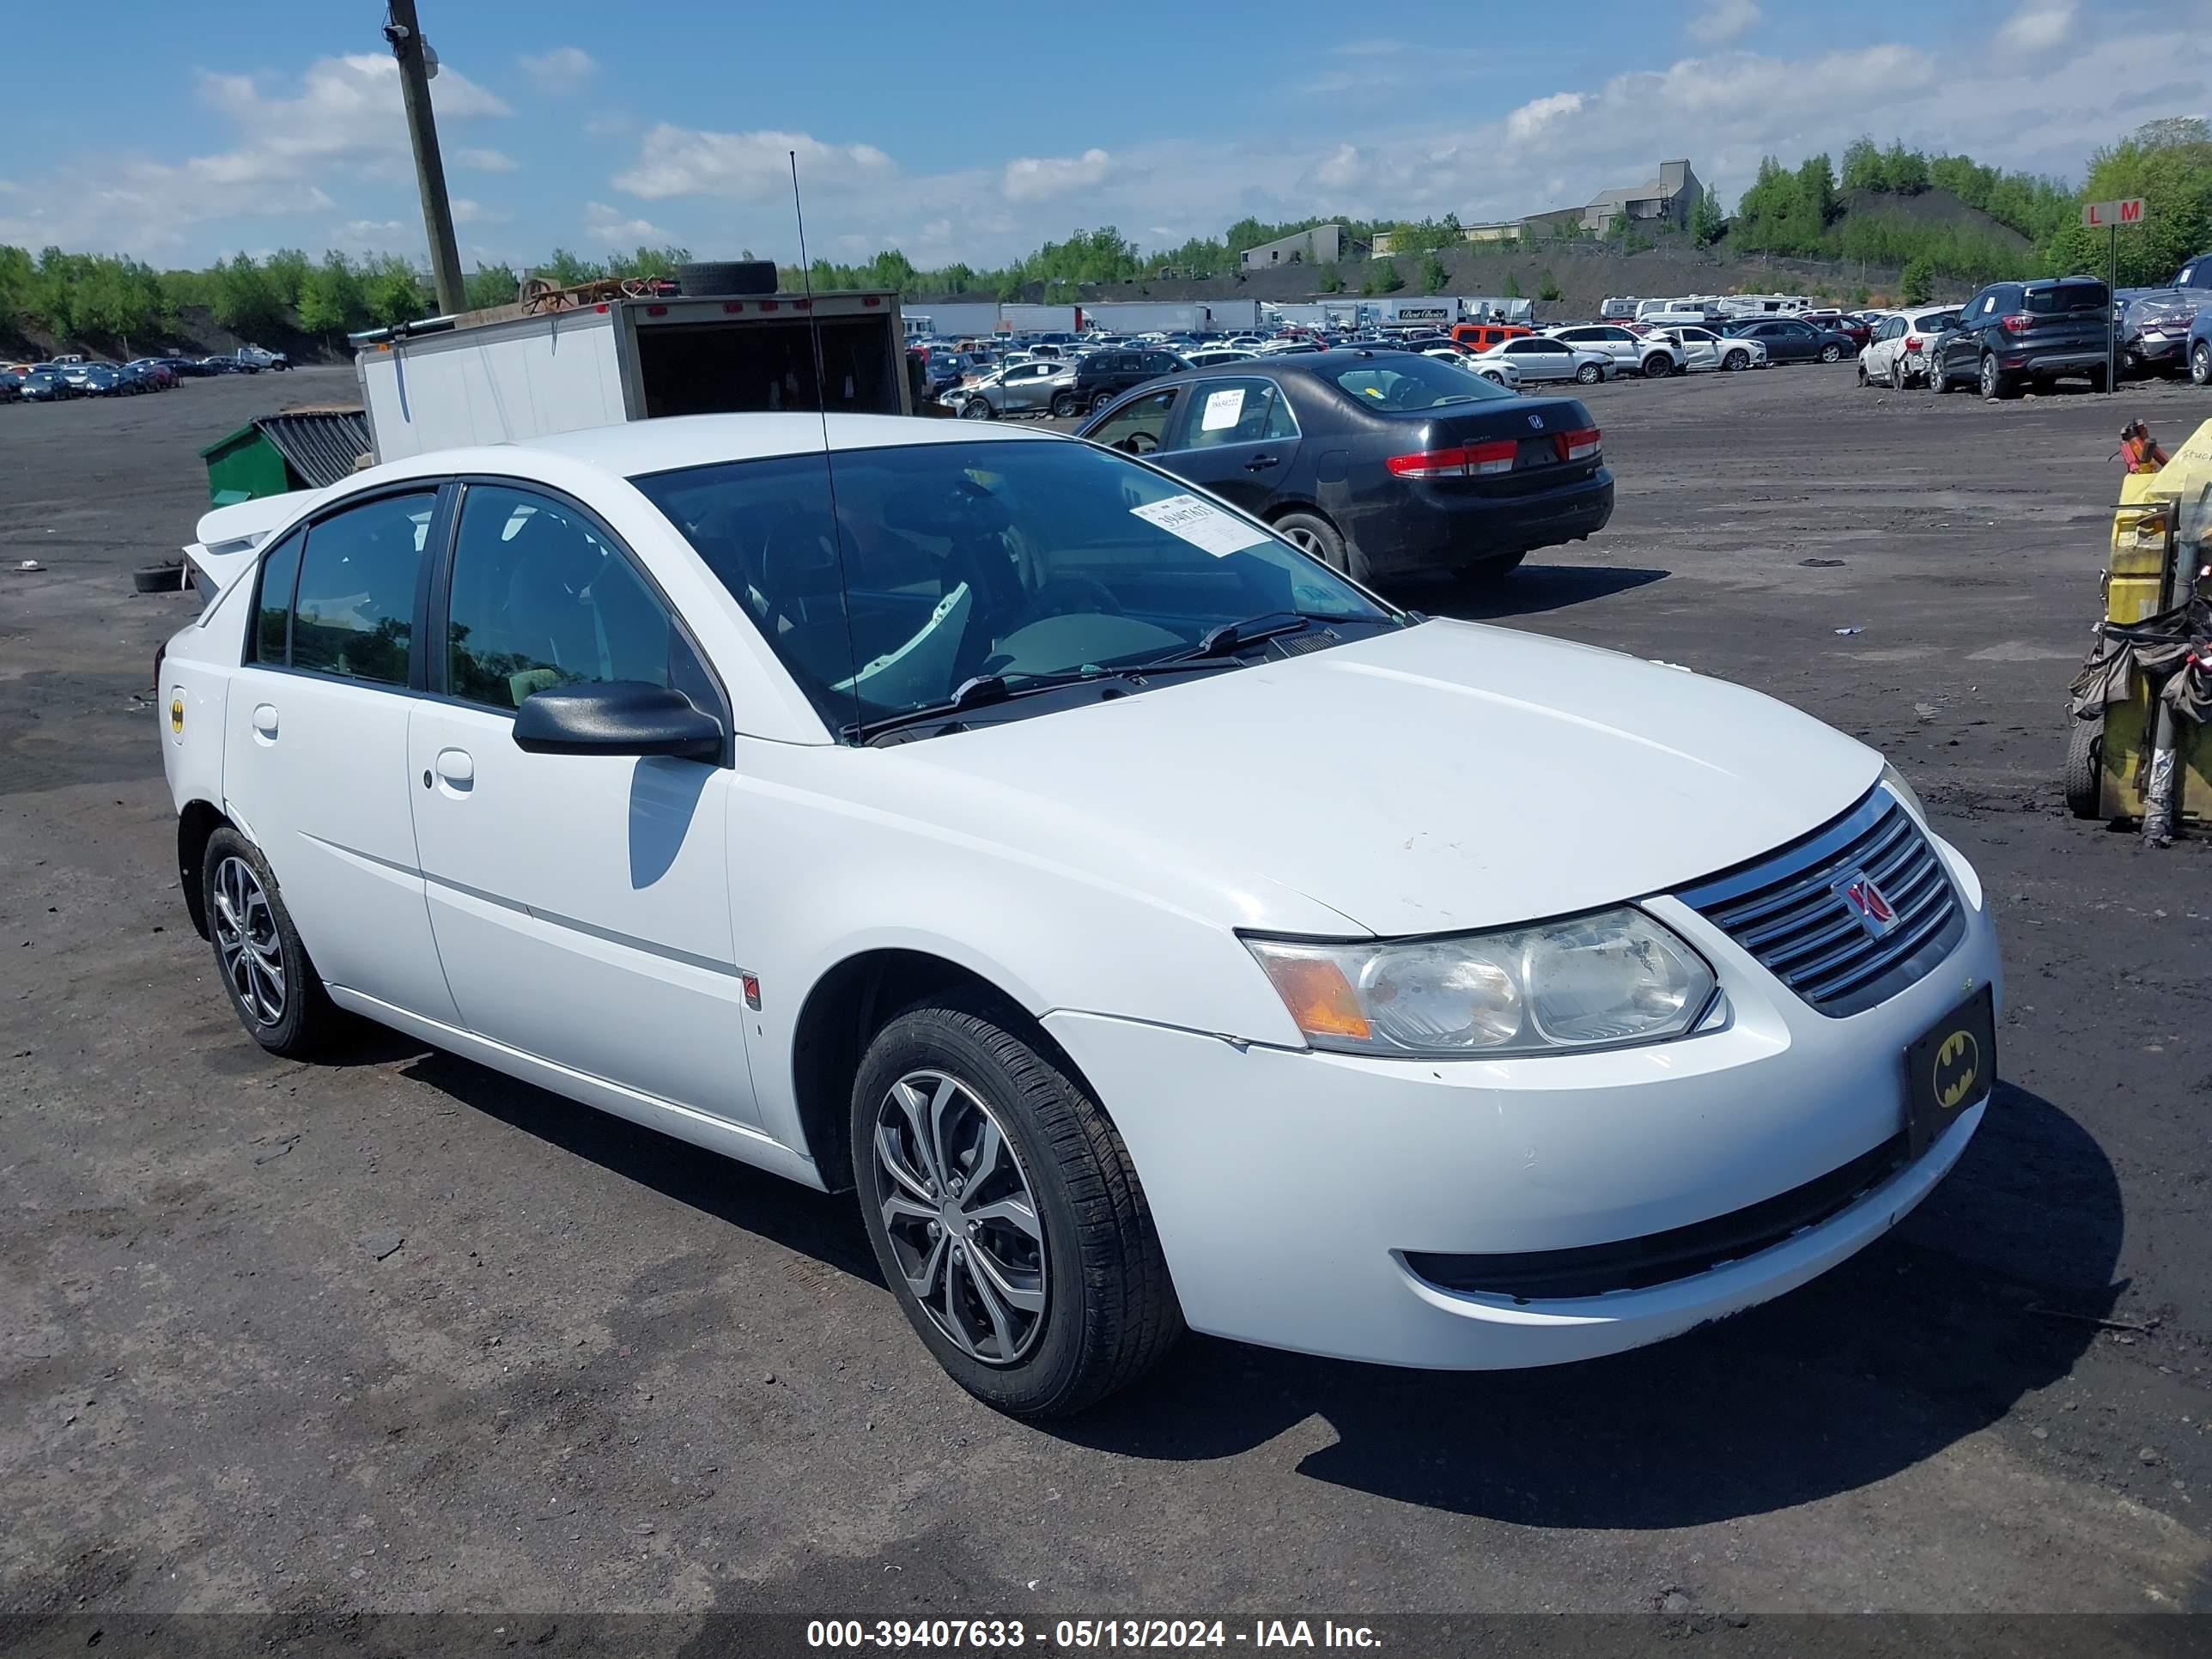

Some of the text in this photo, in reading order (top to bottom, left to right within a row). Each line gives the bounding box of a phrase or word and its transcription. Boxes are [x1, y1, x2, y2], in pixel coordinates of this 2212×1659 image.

[2090, 200, 2140, 225] L M
[1401, 310, 1420, 319] Best
[1158, 503, 1215, 527] 39407633
